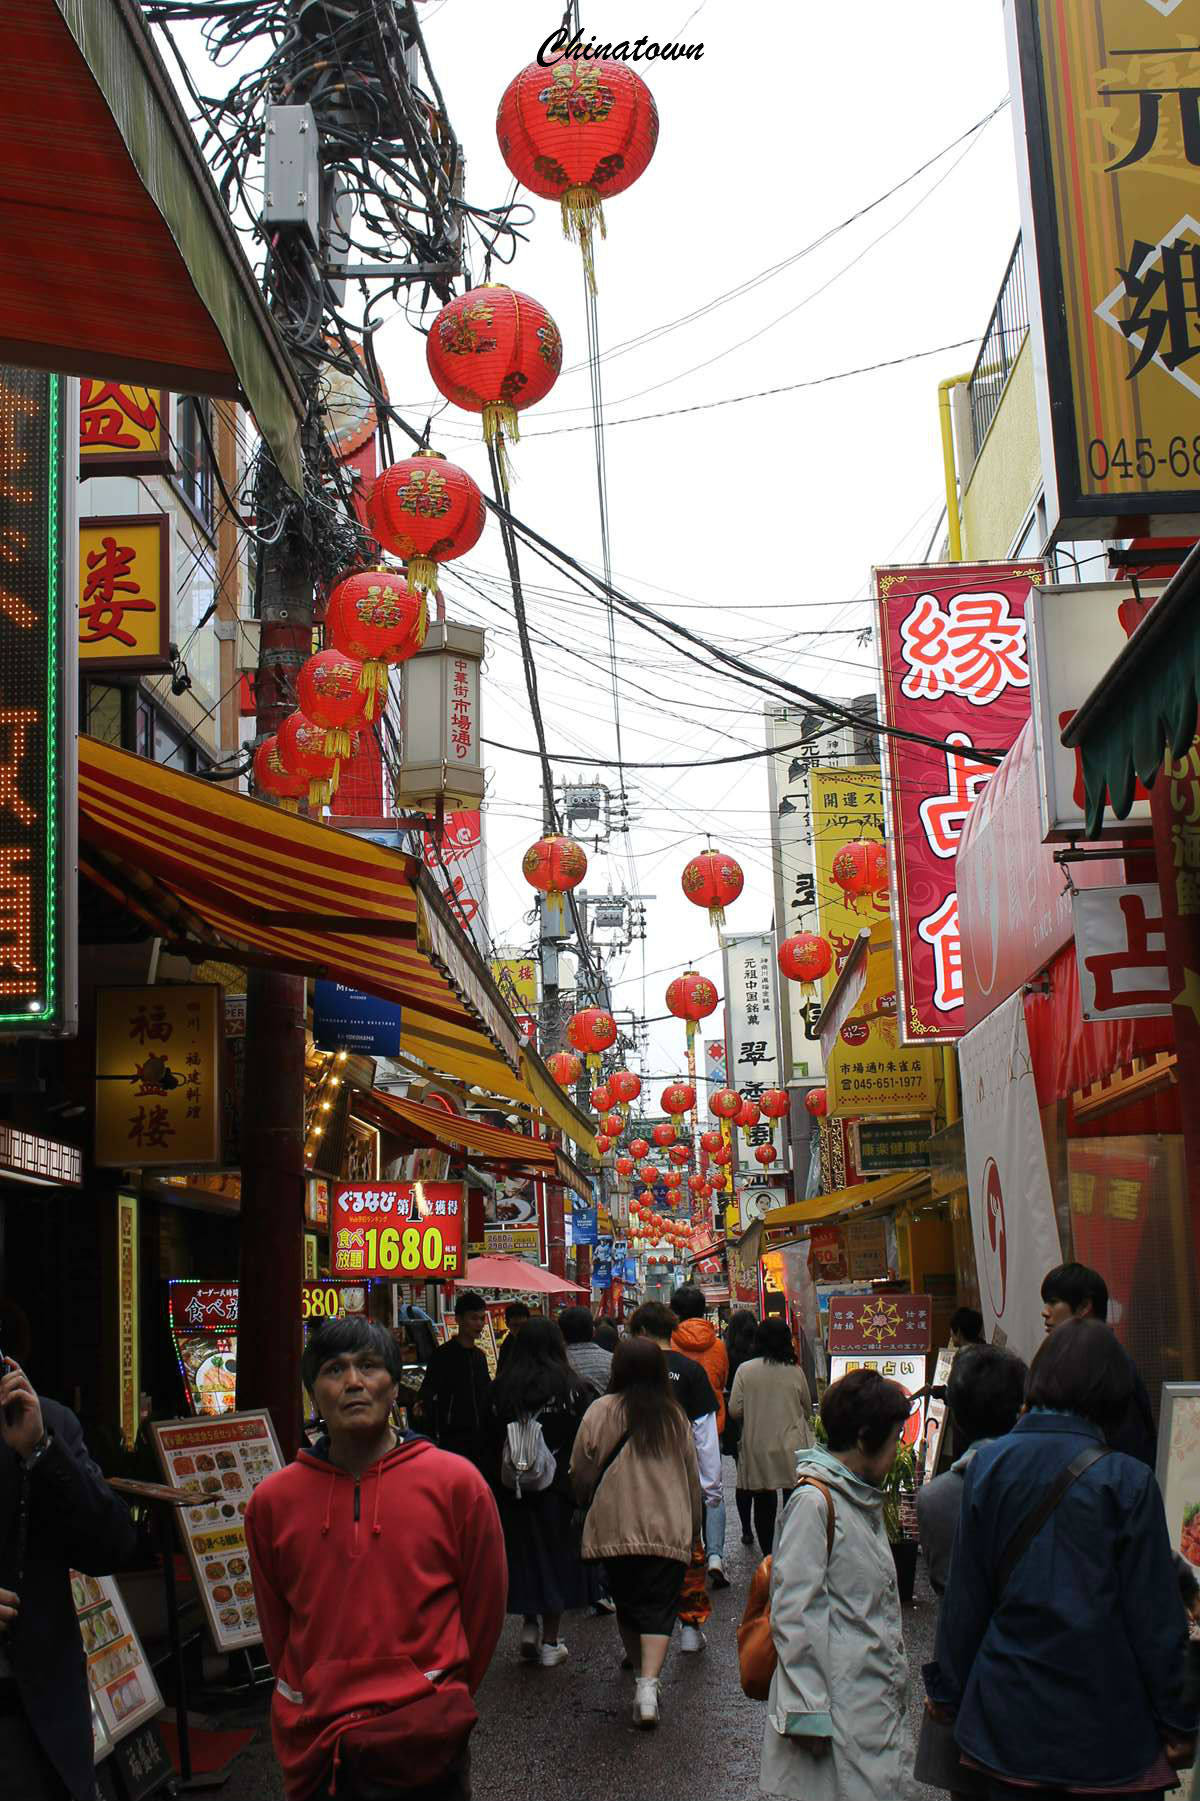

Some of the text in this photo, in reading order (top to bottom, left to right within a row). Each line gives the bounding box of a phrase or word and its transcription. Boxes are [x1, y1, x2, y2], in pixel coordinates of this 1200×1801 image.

[452, 659, 473, 759] 中華街市場通り
[744, 957, 760, 1027] 元祖中国銘菓
[840, 1060, 922, 1076] 市場通り朱雀店
[853, 1075, 922, 1091] 045-651-1977
[338, 1191, 397, 1213] ぐるなび
[365, 1227, 443, 1271] 1680
